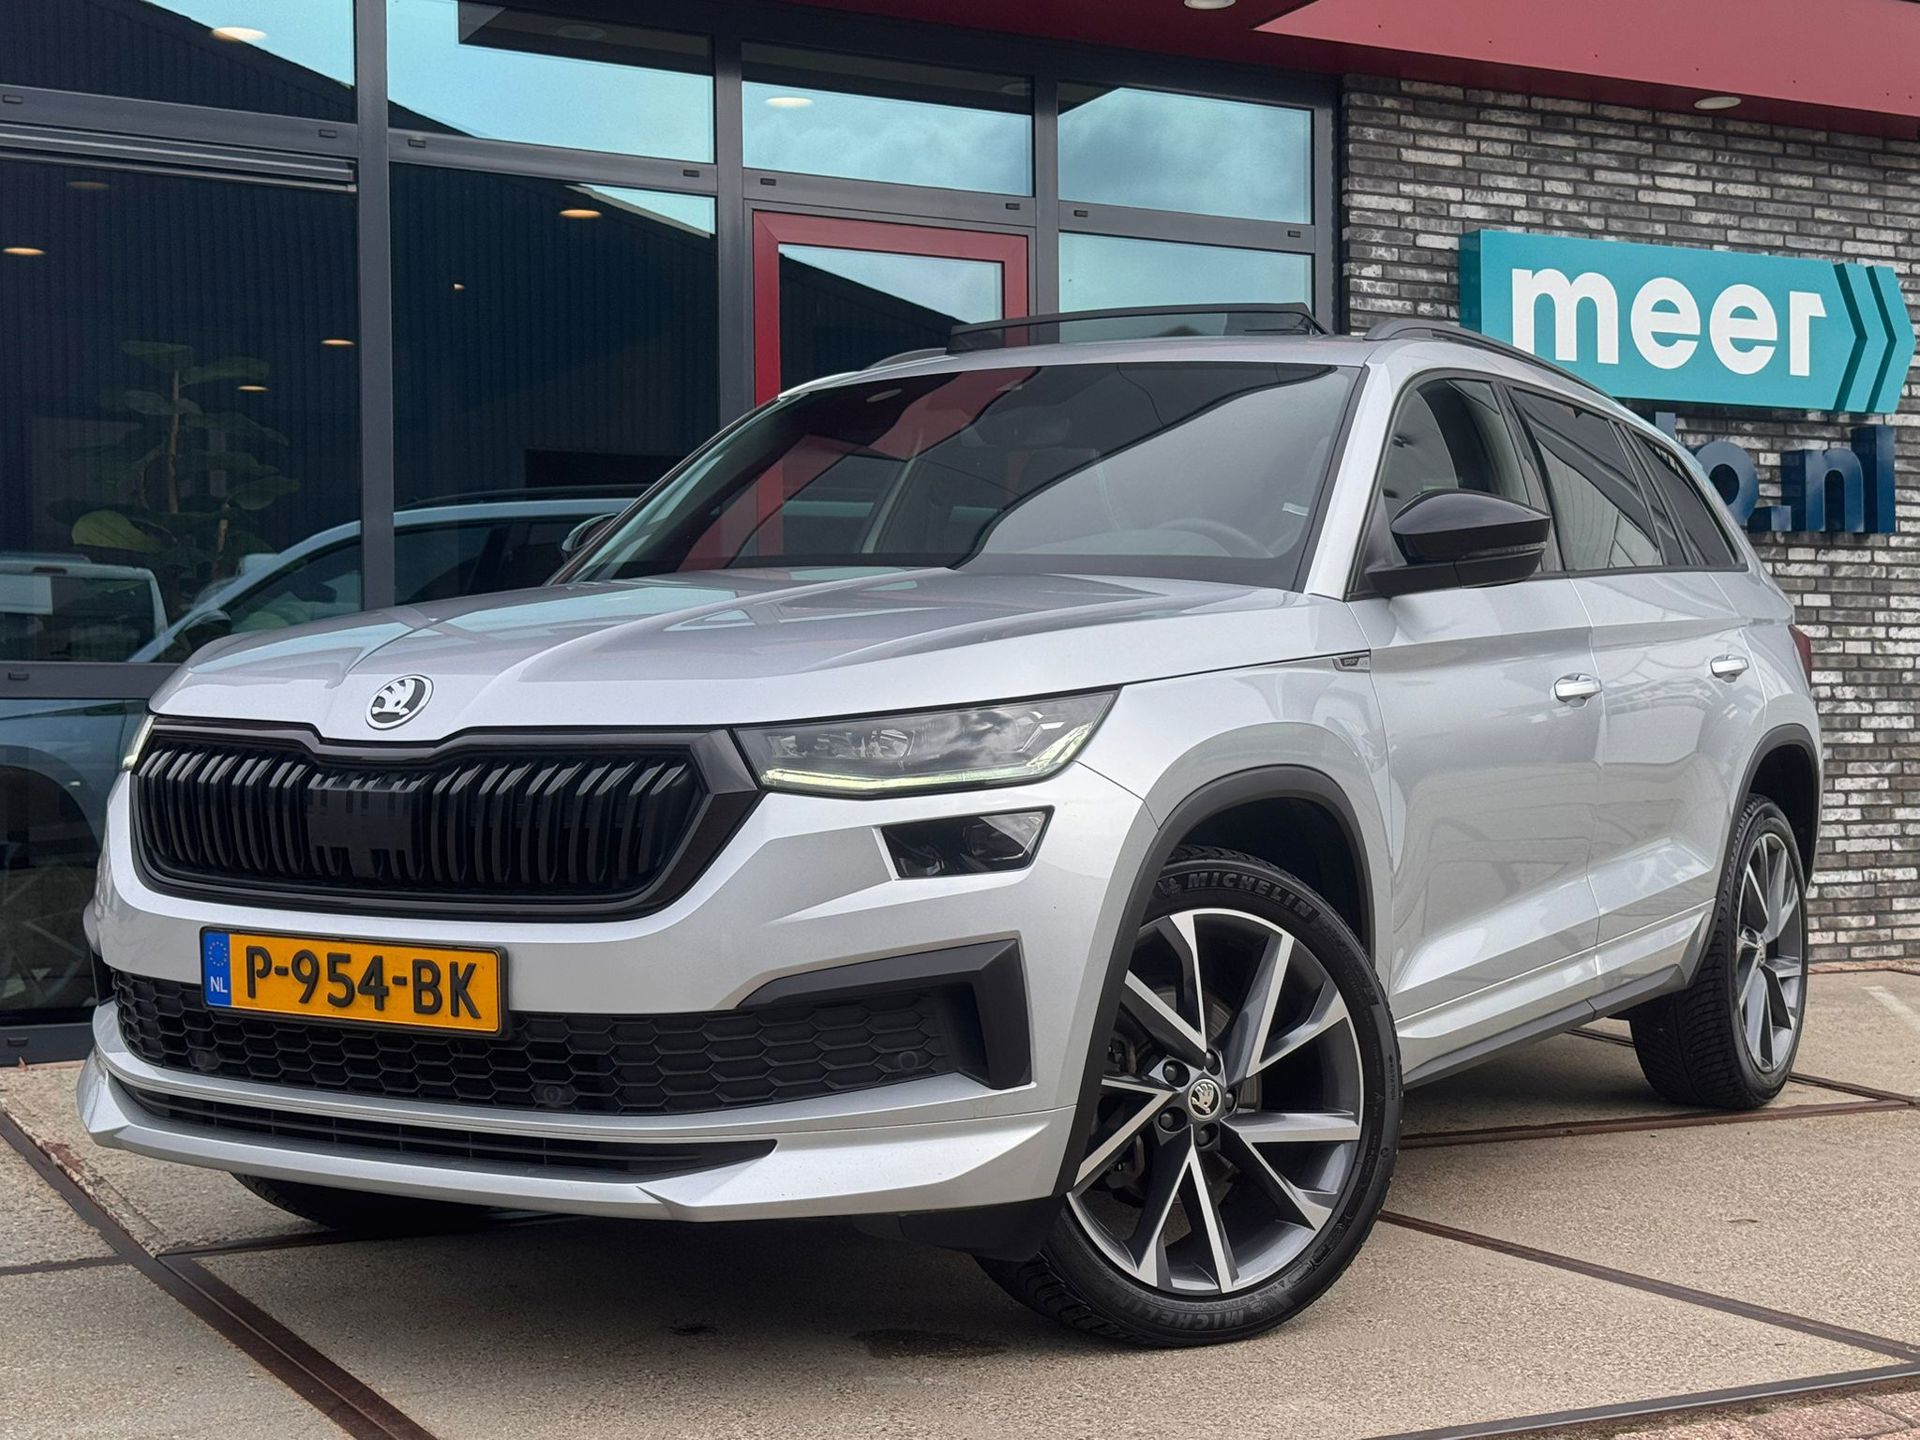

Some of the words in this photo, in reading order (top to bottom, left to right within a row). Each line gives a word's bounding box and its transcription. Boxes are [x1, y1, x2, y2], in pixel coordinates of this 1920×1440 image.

[1511, 268, 1827, 376] meer
[1655, 411, 1895, 534] o.nl
[1187, 871, 1315, 919] MICHELIN
[210, 976, 228, 993] NL
[246, 945, 482, 1020] P-954-BK
